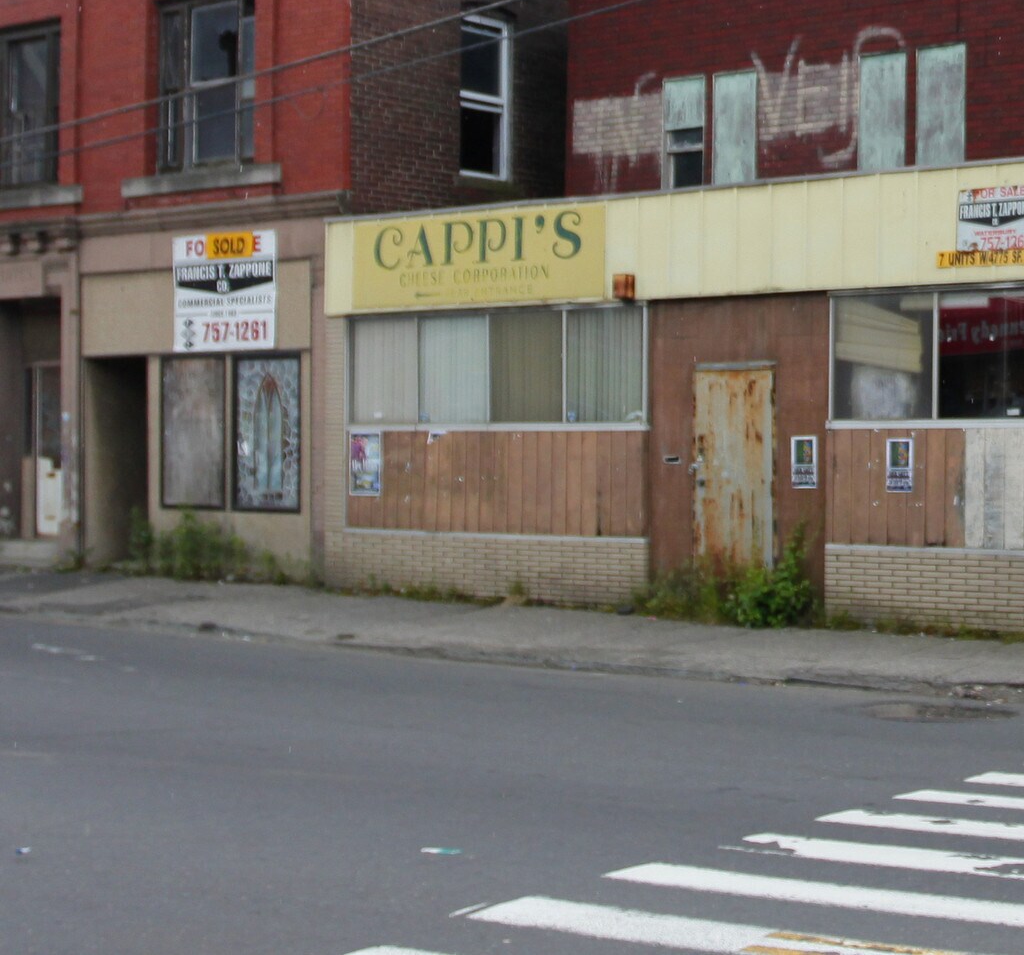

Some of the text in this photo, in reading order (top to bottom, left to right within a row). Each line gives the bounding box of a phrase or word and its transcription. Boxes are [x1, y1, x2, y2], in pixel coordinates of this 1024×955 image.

[960, 203, 990, 219] FRANCIS
[213, 238, 245, 255] SOLD
[374, 211, 582, 271] CAPPI'S
[939, 254, 944, 266] 7
[948, 252, 975, 265] UNITS
[176, 261, 272, 281] FRANCIS T. ZAPPONE
[400, 264, 550, 288] CHEESE CORPORATION
[177, 294, 272, 308] COMMERCIAL SPECIALISTS
[202, 320, 268, 342] 757-1261
